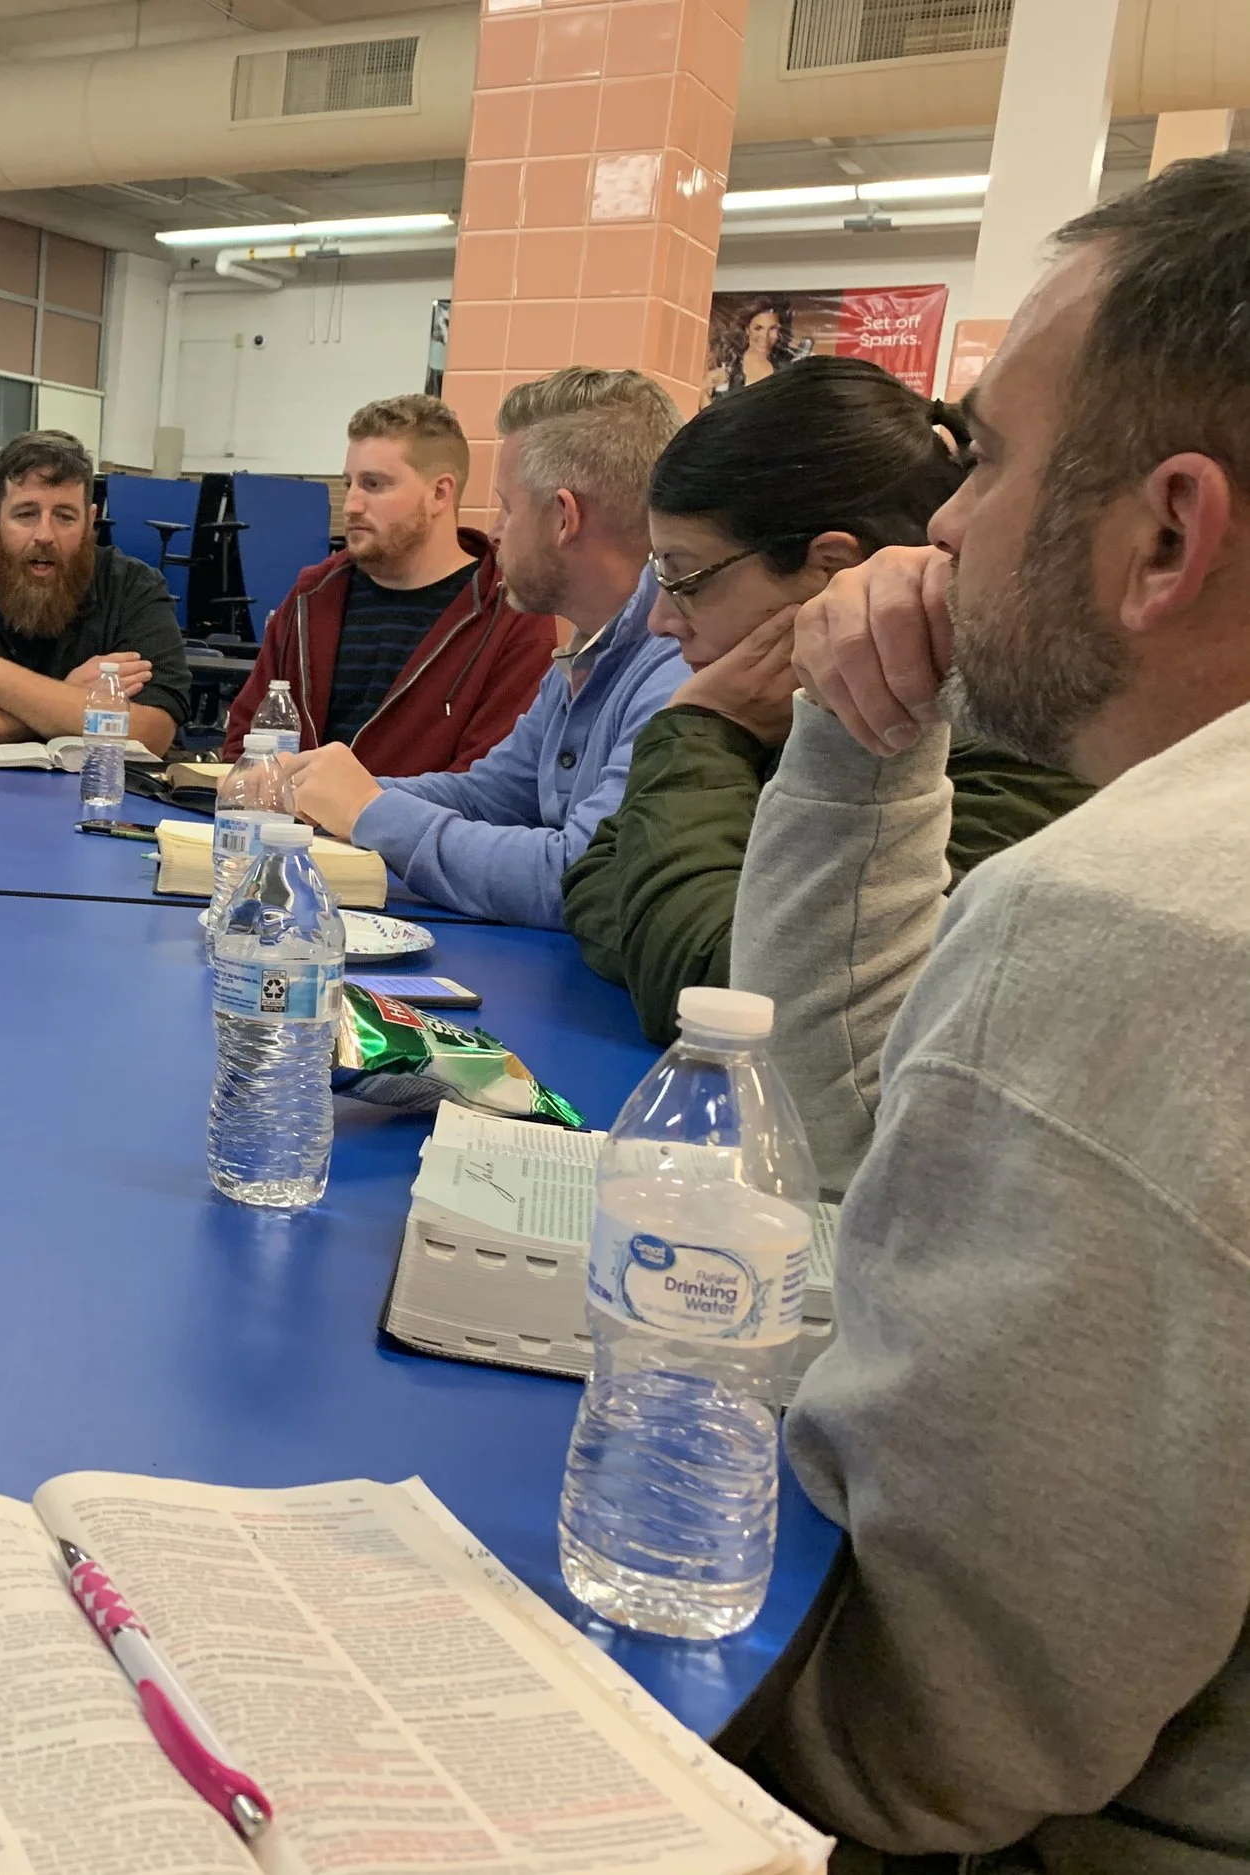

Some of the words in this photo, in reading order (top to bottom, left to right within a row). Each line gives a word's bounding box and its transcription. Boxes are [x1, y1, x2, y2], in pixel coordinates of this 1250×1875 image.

[862, 315, 891, 330] Set
[895, 314, 922, 329] off
[859, 332, 922, 348] Sparks.
[665, 1276, 738, 1304] Drinking
[685, 1296, 736, 1316] Water
